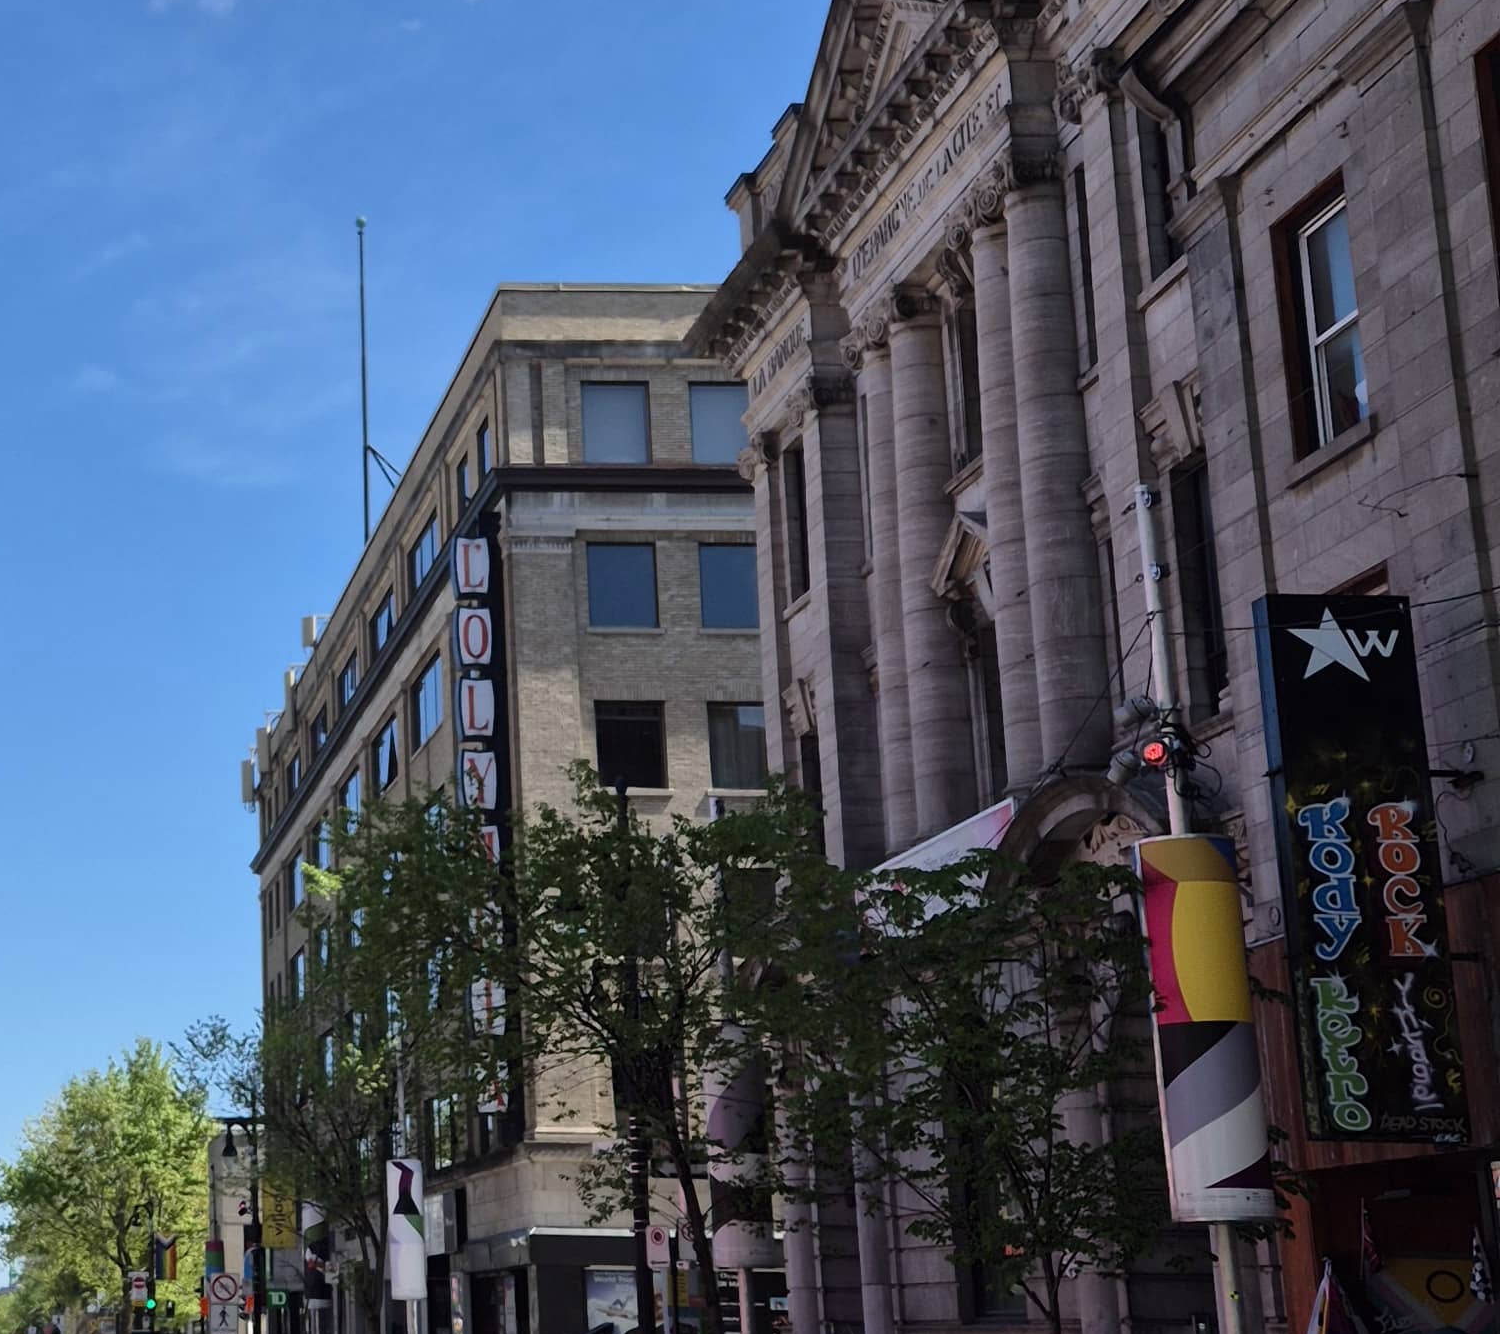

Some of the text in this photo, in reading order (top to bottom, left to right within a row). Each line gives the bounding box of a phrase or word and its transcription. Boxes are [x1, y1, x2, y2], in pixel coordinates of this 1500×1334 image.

[1345, 628, 1400, 658] W
[1419, 1116, 1468, 1134] STOCK
[267, 1291, 287, 1305] TD
